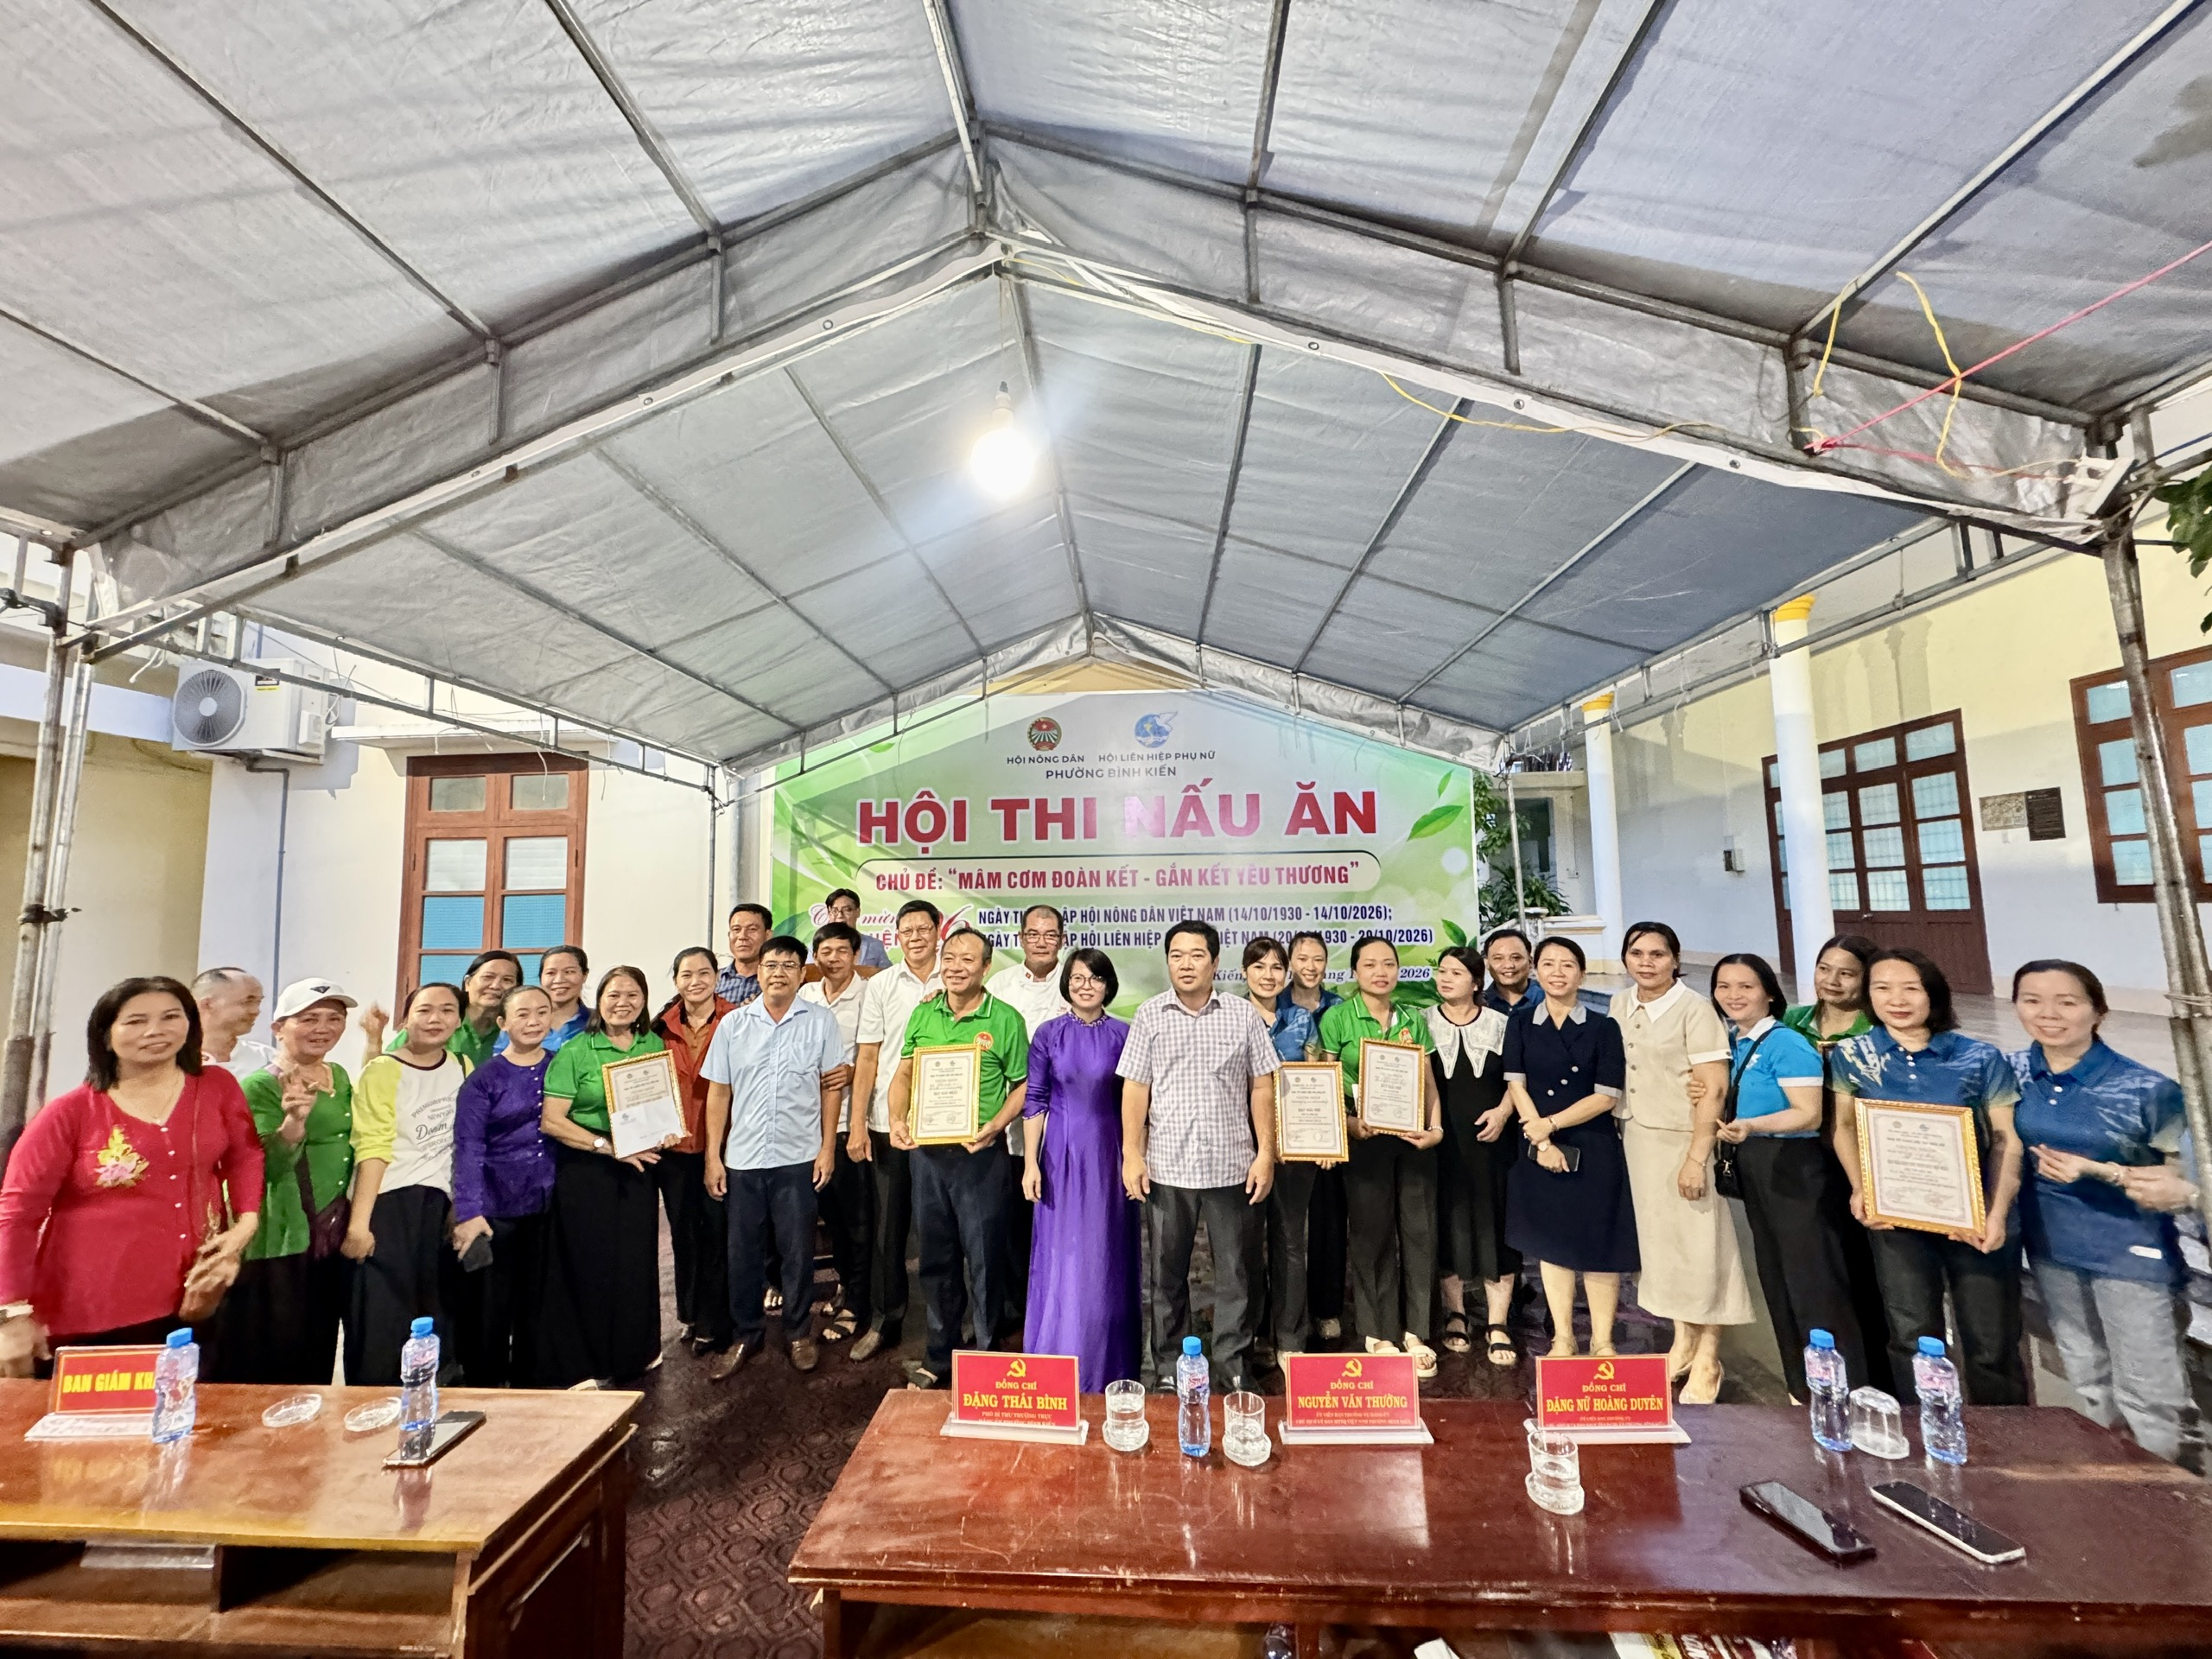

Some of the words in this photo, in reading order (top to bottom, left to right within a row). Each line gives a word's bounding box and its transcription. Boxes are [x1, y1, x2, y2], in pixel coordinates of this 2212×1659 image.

[1007, 755, 1026, 765] HỘI
[1029, 755, 1059, 764] NÔNG
[1062, 753, 1084, 763] DÂN
[1098, 753, 1118, 763] HỘI
[1121, 753, 1144, 762] LIÊN
[1147, 752, 1172, 762] HIỆP
[1174, 753, 1198, 762] PHỤ
[1200, 750, 1216, 760] NỮ
[1046, 766, 1104, 779] PHƯỜNG
[1108, 766, 1141, 778] BÌNH
[1145, 764, 1176, 777] KIẾN
[859, 790, 967, 855] HỘI
[990, 797, 1097, 842] THI
[1123, 778, 1260, 838] NẤU
[1285, 781, 1376, 836] ĂN
[876, 868, 909, 891] CHỦ
[1007, 869, 1046, 889] CƠM
[1052, 867, 1101, 888] ĐOÀN
[1106, 863, 1139, 887] KẾT
[1156, 861, 1192, 887] GẮN
[1198, 861, 1230, 887] KẾT
[1237, 863, 1270, 886] YÊU
[979, 906, 1009, 925] NGÀY
[1063, 906, 1077, 926] ẬP
[1081, 906, 1100, 926] HỘI
[1104, 906, 1136, 924] NÔNG
[1141, 906, 1165, 922] DÂN
[1198, 907, 1224, 921] NAM
[1229, 906, 1302, 923] (14/10/1930
[1314, 905, 1393, 922] 14/10/2026);
[1081, 929, 1100, 950] HỘI
[1104, 929, 1130, 947] LIÊN
[1135, 929, 1162, 949] HIỆP
[1219, 928, 1238, 948] IỆT
[1400, 969, 1430, 980] 2026
[63, 1374, 92, 1393] BAN
[95, 1370, 131, 1392] GIÁM
[995, 1378, 1020, 1389] ĐỒNG
[1021, 1380, 1037, 1390] CHÍ
[1330, 1378, 1355, 1389] ĐỒNG
[1357, 1380, 1374, 1389] CHÍ
[1582, 1382, 1607, 1392] ĐỒNG
[1610, 1382, 1626, 1392] CHÍ
[963, 1391, 998, 1409] ĐẶNG
[1001, 1392, 1033, 1409] THÁI
[1036, 1393, 1068, 1410] BÌNH
[1341, 1393, 1363, 1408] VĂN
[1365, 1393, 1408, 1408] THƯỜNG
[1547, 1396, 1574, 1415] ĐẶNG
[1576, 1395, 1591, 1411] NỮ
[1593, 1395, 1628, 1411] HOÀNG
[1630, 1394, 1663, 1411] DUYÊN
